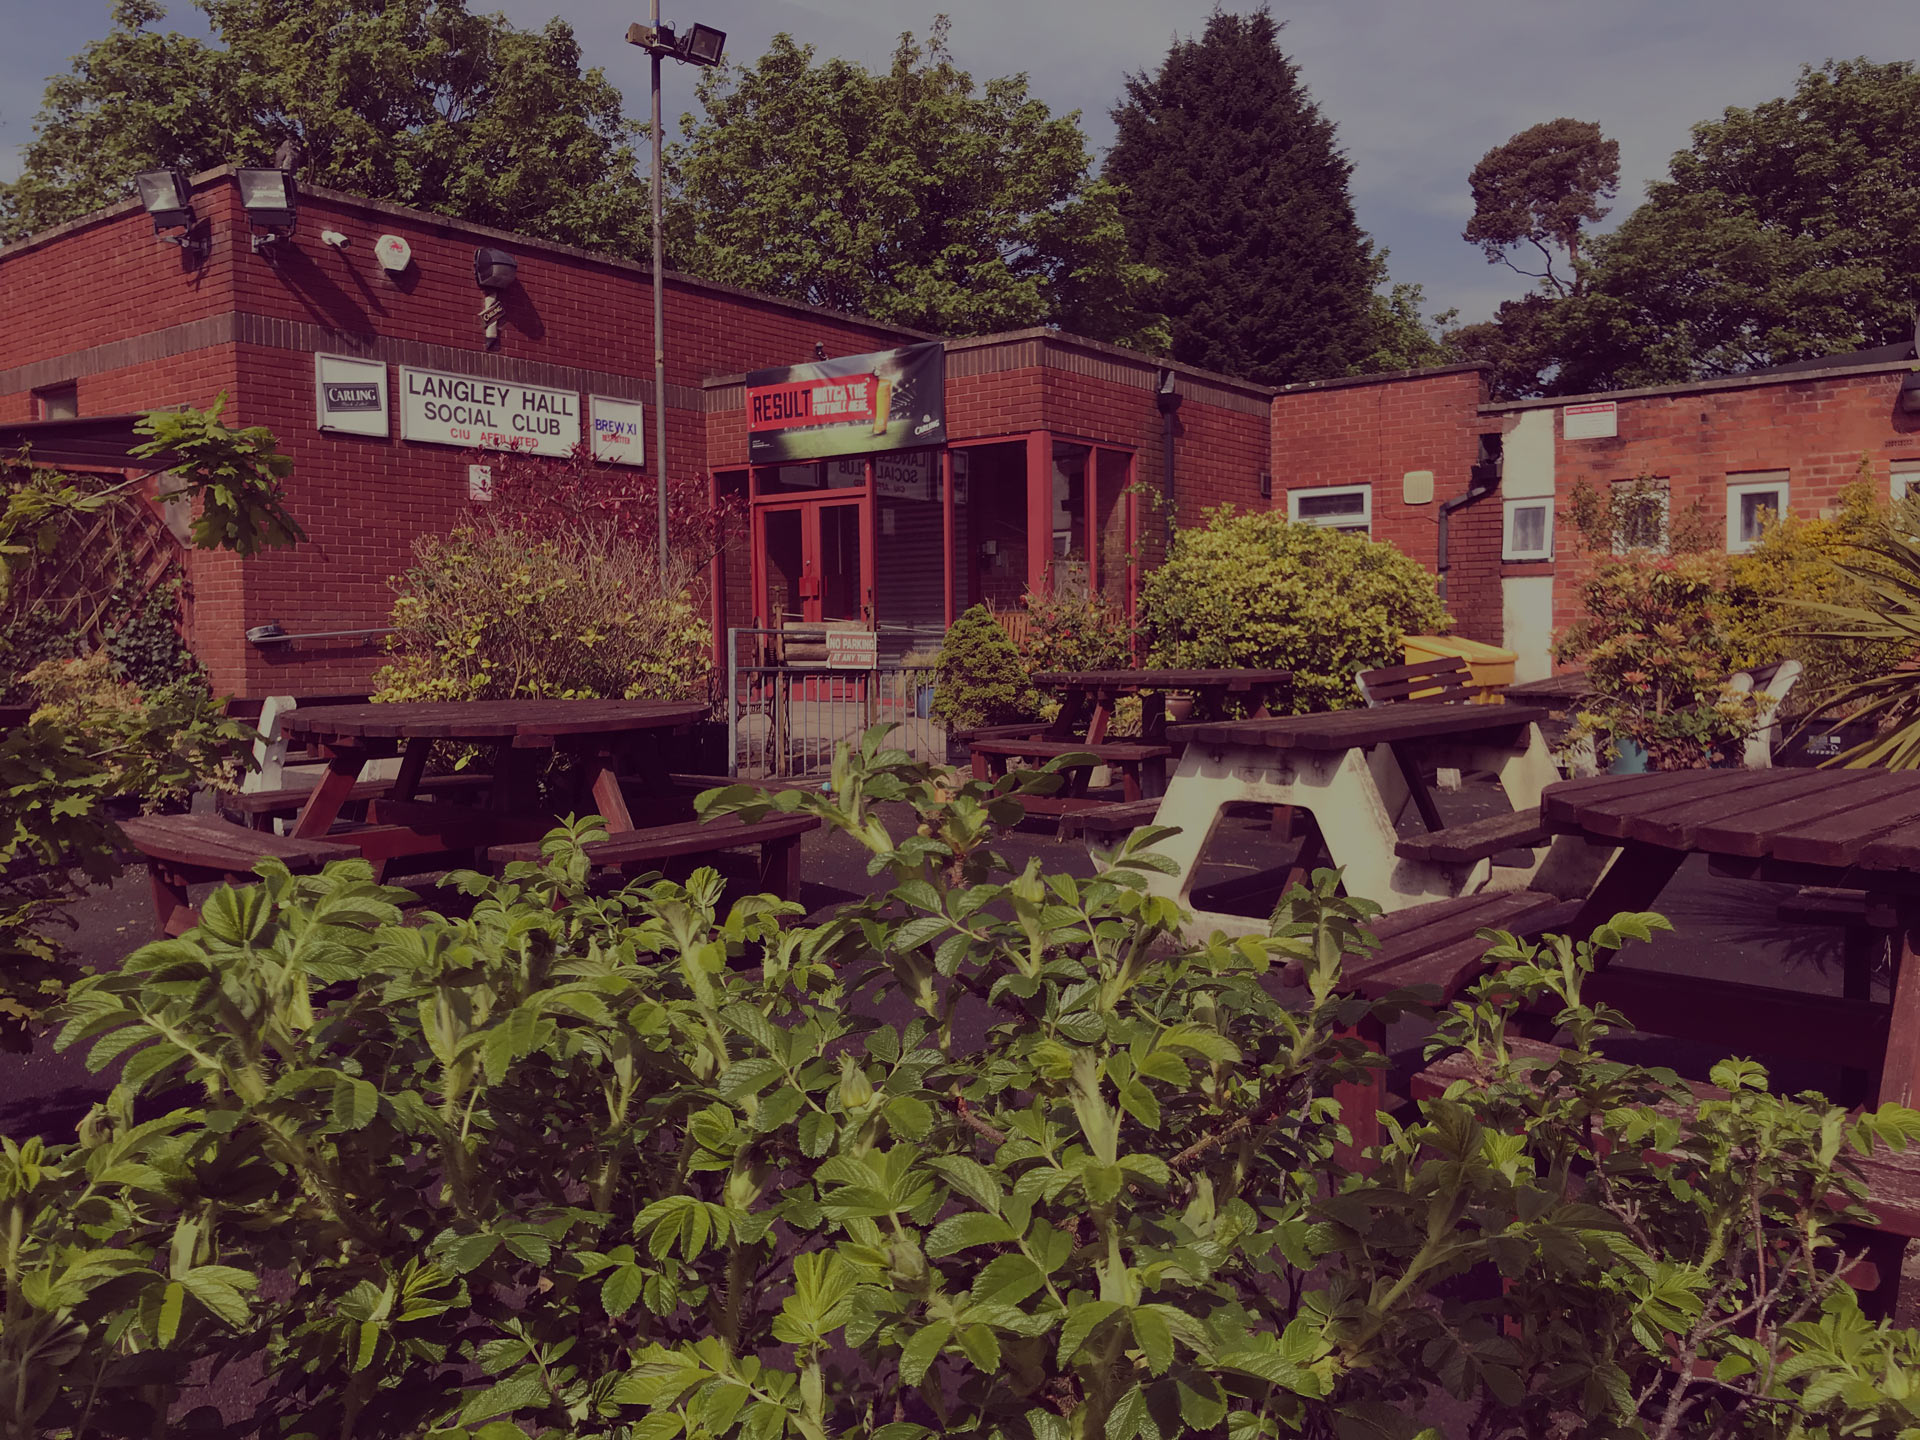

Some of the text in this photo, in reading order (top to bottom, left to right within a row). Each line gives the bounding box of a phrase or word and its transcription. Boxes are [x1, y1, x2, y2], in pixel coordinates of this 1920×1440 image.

[329, 388, 377, 402] CARLING
[408, 374, 573, 416] LANGLEY HALL
[812, 382, 868, 403] WATCH THE
[753, 389, 811, 423] RESULT
[812, 400, 848, 417] FOOTBALL
[424, 401, 561, 436] SOCIAL CLUB
[595, 418, 637, 435] BREW XI
[450, 428, 471, 440] CIU
[829, 637, 874, 650] NO PARKING
[832, 653, 872, 663] AT ANY TIME
